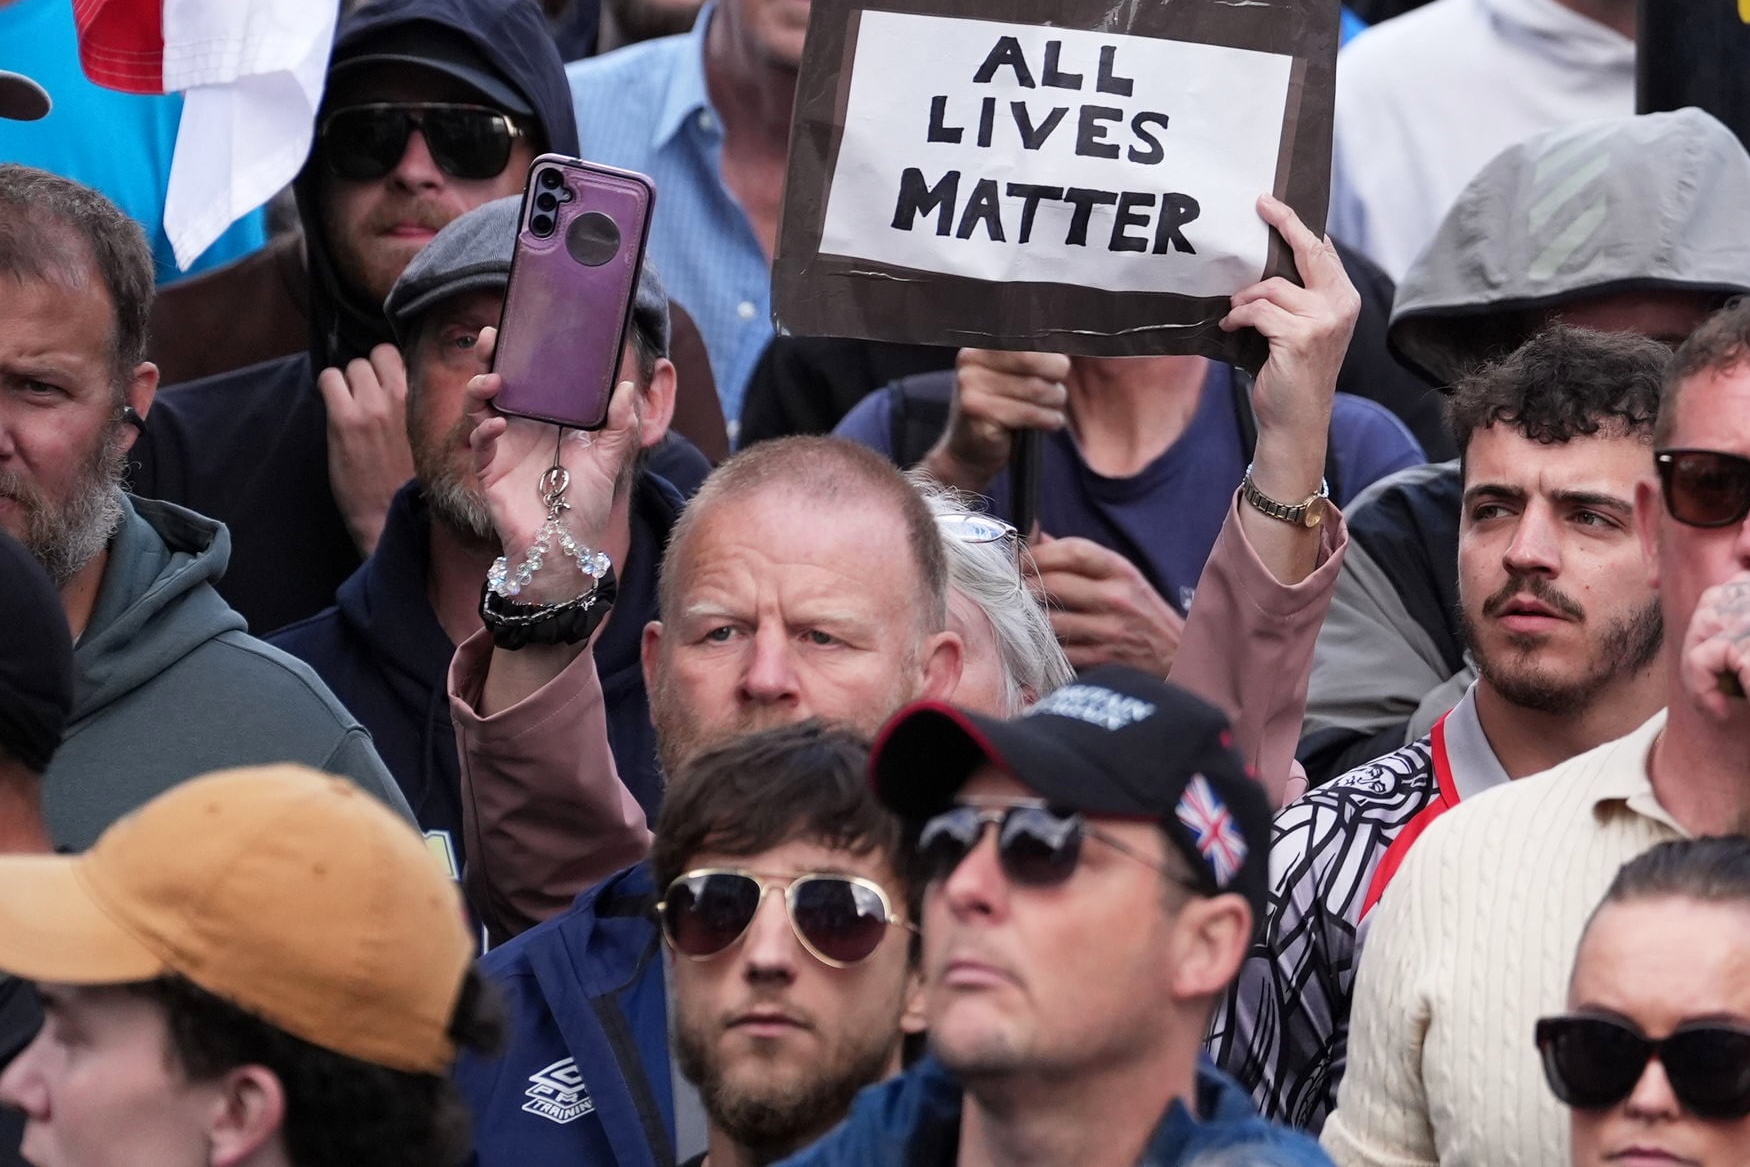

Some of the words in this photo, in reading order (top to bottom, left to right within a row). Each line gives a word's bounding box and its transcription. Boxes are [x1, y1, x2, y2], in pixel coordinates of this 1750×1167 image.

[972, 35, 1135, 98] ALL
[926, 95, 1170, 166] LIVES
[890, 166, 1201, 255] MATTER
[532, 1099, 593, 1120] TRAININ
